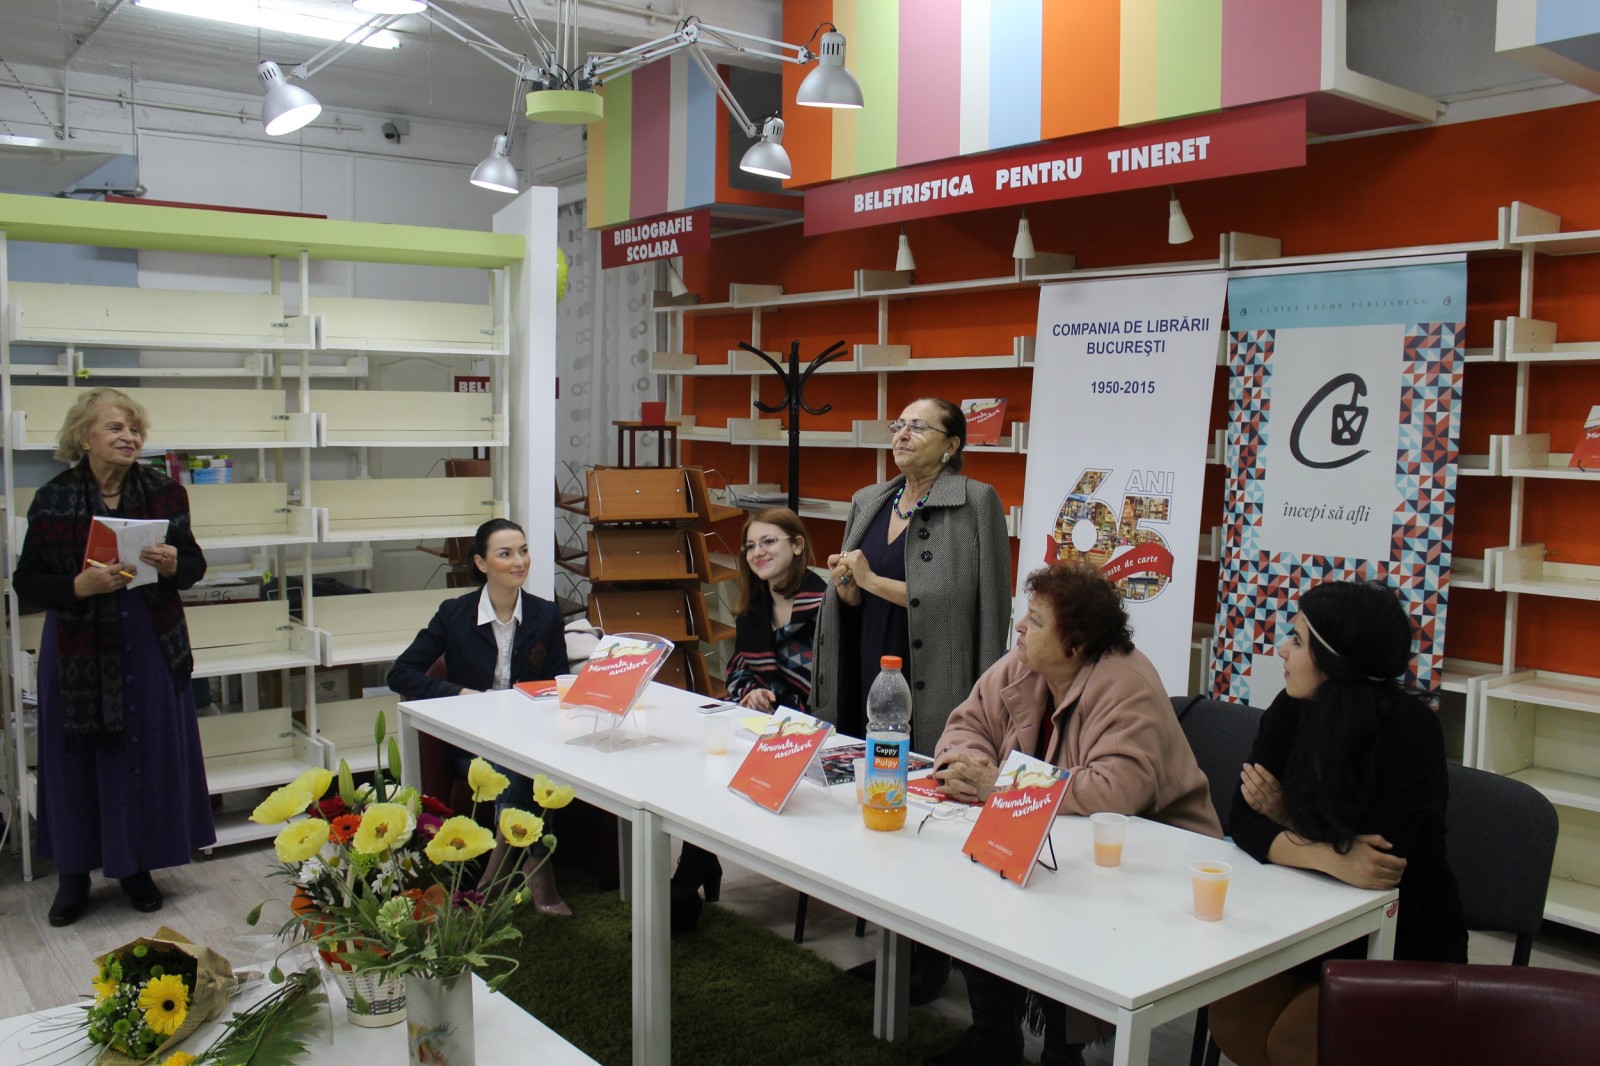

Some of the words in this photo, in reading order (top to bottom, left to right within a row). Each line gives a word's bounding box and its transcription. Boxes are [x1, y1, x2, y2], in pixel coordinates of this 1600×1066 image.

[854, 174, 974, 213] BELETRISTICA
[996, 156, 1083, 190] PENTRU
[1108, 135, 1211, 174] TINERET
[614, 215, 693, 246] BIBLIOGRAFIE
[626, 238, 679, 262] SCOLARA
[1052, 321, 1120, 337] COMPANIA
[1123, 320, 1143, 334] DE
[1147, 315, 1210, 333] LIBRĂRII
[1091, 381, 1156, 394] 1950-2015
[1124, 470, 1175, 494] ANI
[1283, 501, 1327, 522] începi
[1327, 505, 1345, 520] să
[1346, 504, 1371, 525] afli
[1124, 559, 1134, 569] de
[1137, 555, 1158, 565] carte
[757, 739, 794, 753] Minunata
[774, 739, 813, 760] aventură
[876, 746, 898, 756] Cappy
[875, 758, 898, 769] Pulpy
[991, 792, 1032, 808] Minunata
[1012, 793, 1052, 818] aventură
